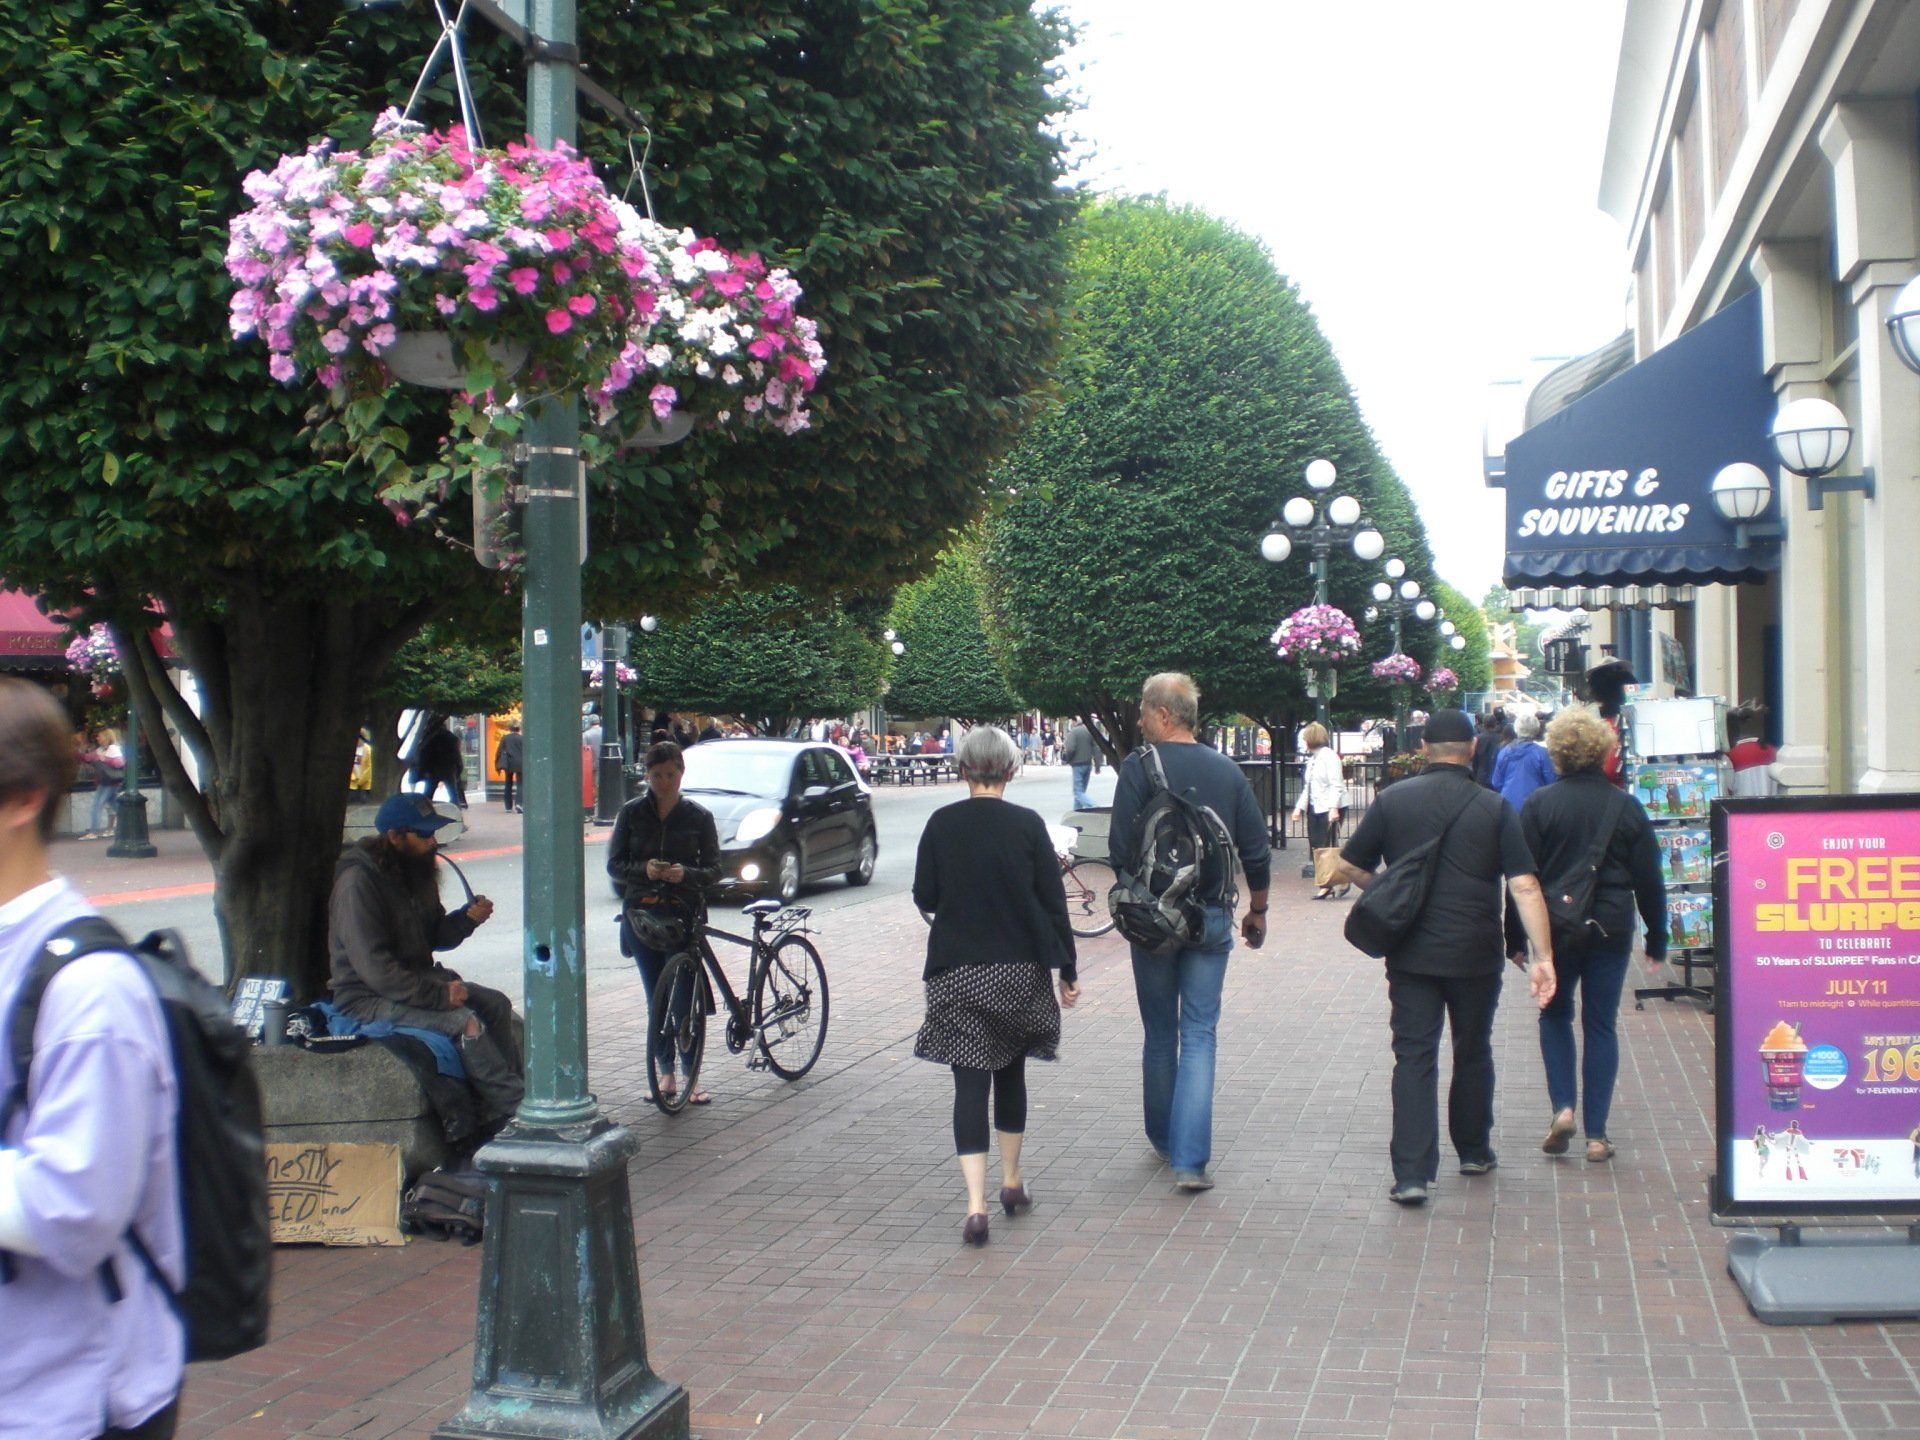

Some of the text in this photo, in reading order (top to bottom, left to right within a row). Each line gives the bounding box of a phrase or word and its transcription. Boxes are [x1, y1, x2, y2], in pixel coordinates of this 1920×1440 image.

[1545, 467, 1660, 500] GIFTS &
[1518, 503, 1690, 537] SOUVENIRS
[1660, 833, 1700, 847] Aidan
[1823, 837, 1886, 850] ENJOY YOUR
[1787, 857, 1920, 900] FREE
[1819, 937, 1891, 949] TO CELEBRATE
[1756, 957, 1771, 966] 50
[1772, 957, 1800, 966] Years
[1802, 957, 1813, 966] of
[1872, 955, 1897, 965] Fans
[1898, 956, 1907, 964] in
[1825, 979, 1888, 995] JULY 11
[1863, 1044, 1920, 1082] 196
